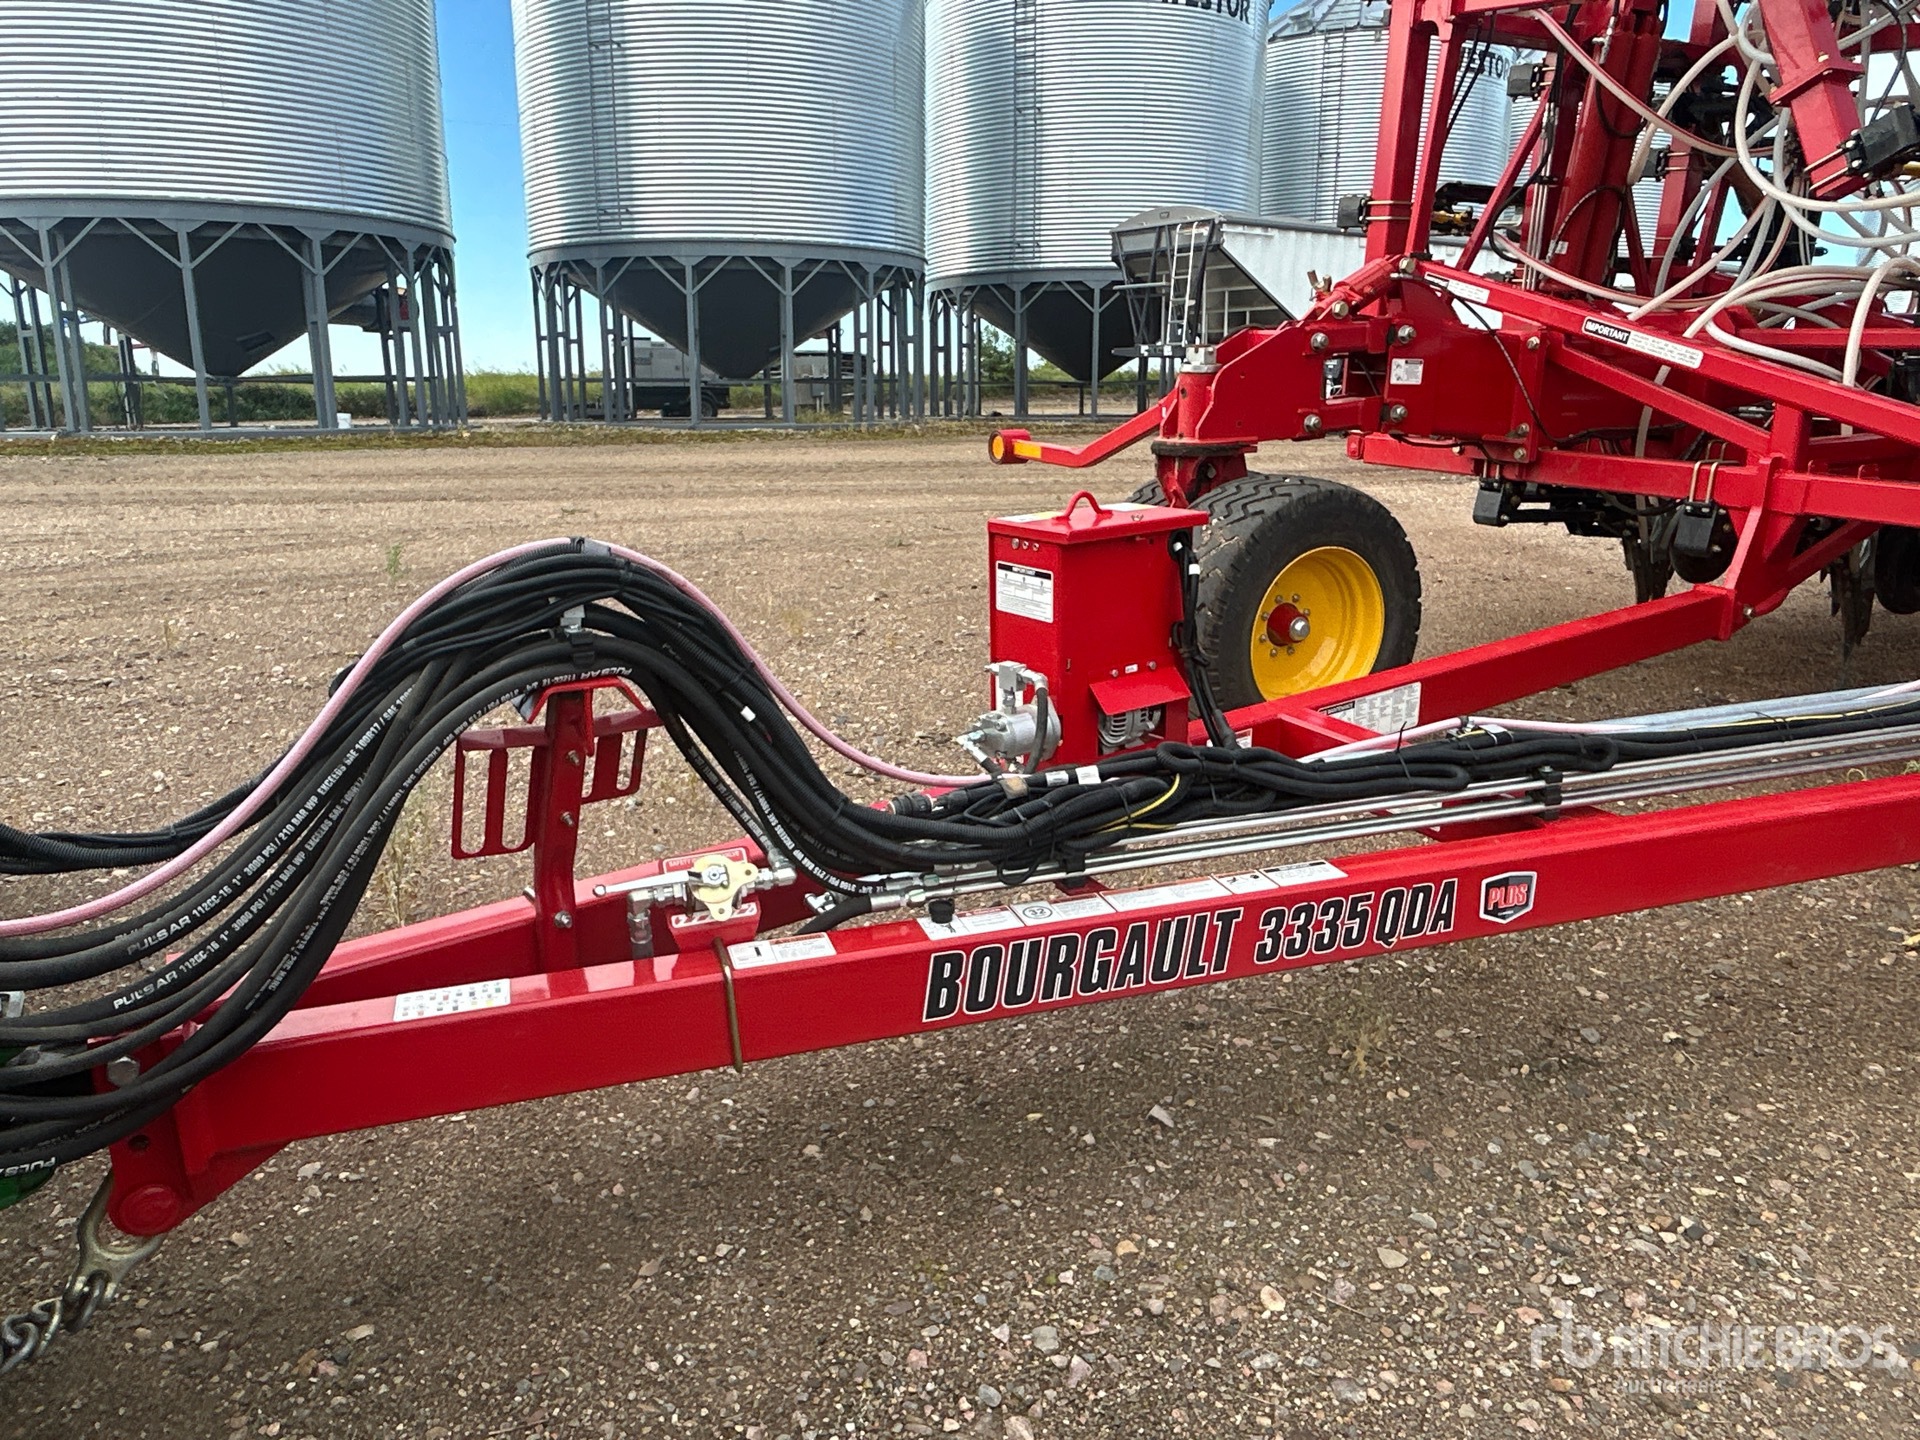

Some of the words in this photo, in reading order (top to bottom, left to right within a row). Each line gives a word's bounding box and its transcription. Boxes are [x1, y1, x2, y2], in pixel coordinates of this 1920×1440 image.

[1585, 321, 1628, 342] IMPORTANT
[126, 914, 192, 957] PULSAR
[192, 885, 232, 919] 112CC-16
[244, 854, 265, 876] 3000
[262, 842, 278, 858] PSI
[278, 823, 295, 841] 210
[291, 807, 309, 826] BAR
[304, 794, 319, 810] WP
[343, 749, 358, 765] SAE
[357, 723, 382, 751] 100R17
[382, 705, 398, 721] SAE
[668, 857, 690, 867] SAFETY
[1487, 883, 1528, 911] PLUS
[1028, 908, 1046, 916] 32
[112, 967, 178, 1012] PULSAR
[179, 940, 220, 974] 112CC-16
[231, 910, 253, 932] 3000
[249, 898, 266, 914] PSI
[279, 863, 297, 882] BAR
[292, 850, 307, 866] WP
[922, 908, 1242, 1023] BOURGAULT
[0, 1156, 56, 1178] PULS
